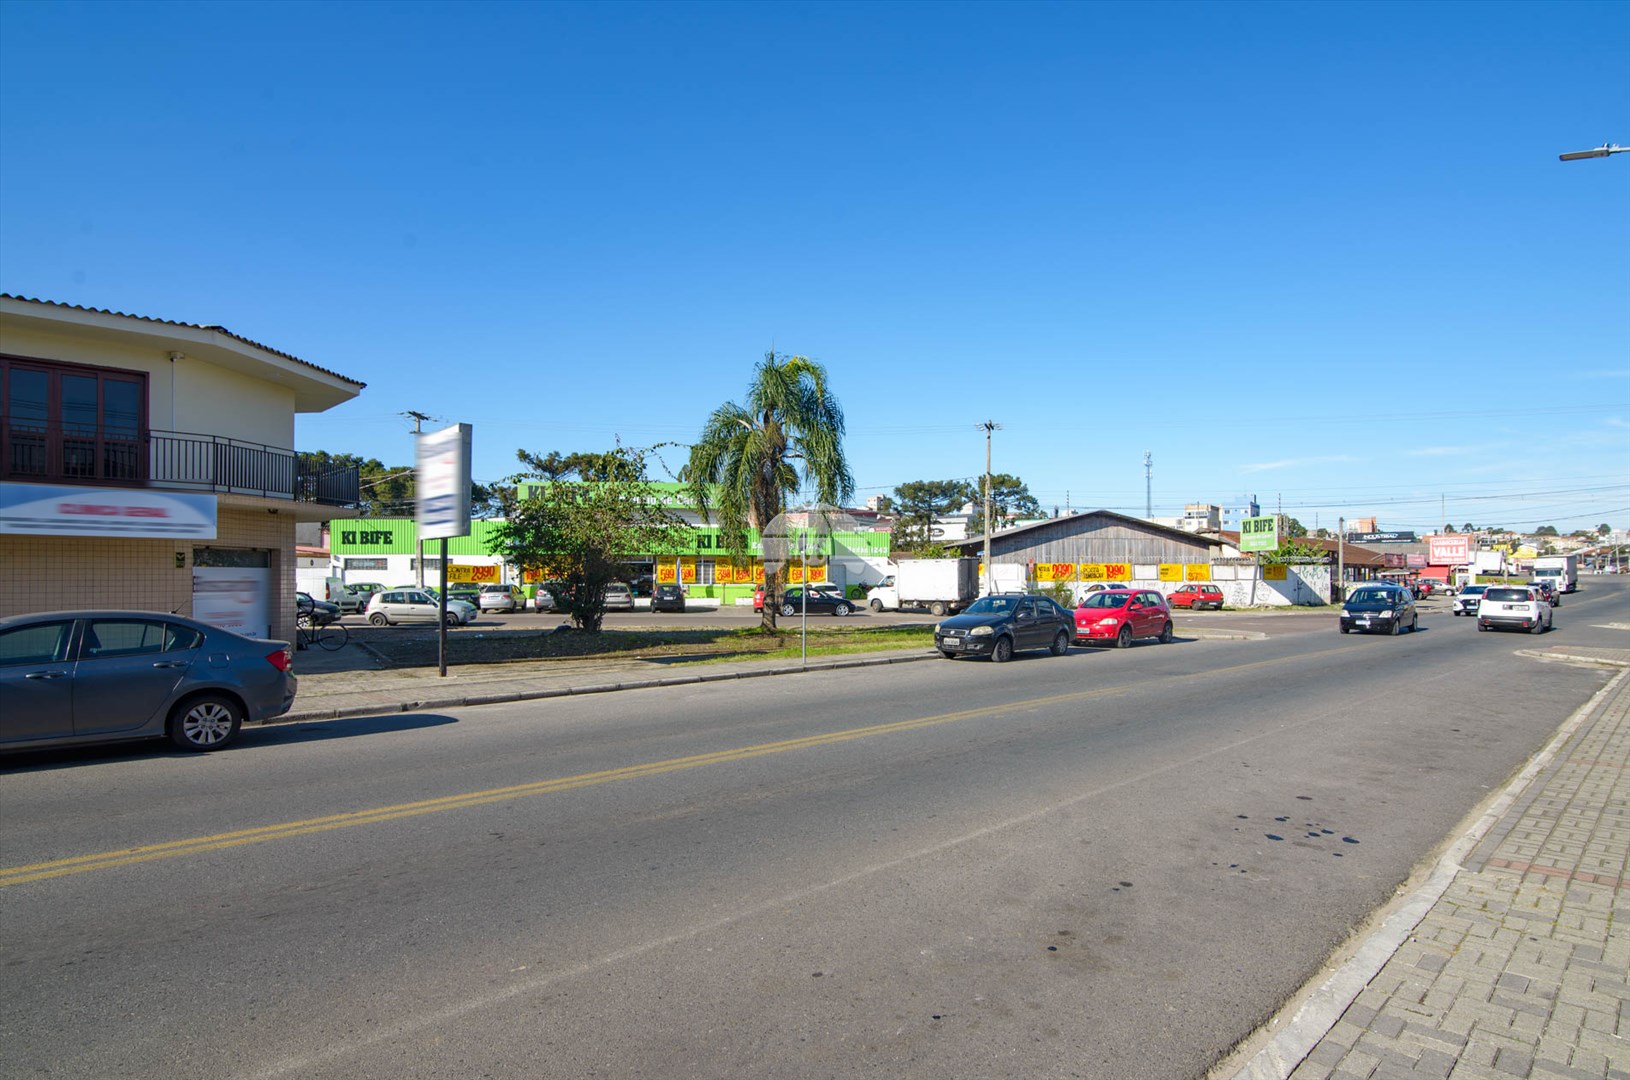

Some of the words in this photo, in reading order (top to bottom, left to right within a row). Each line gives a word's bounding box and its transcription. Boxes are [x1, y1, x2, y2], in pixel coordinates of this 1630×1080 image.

[528, 485, 546, 501] KI
[1242, 521, 1252, 533] KI
[1253, 518, 1274, 532] BIFE
[341, 530, 357, 545] KI
[359, 530, 393, 545] BIFE
[1433, 546, 1465, 557] VALLE
